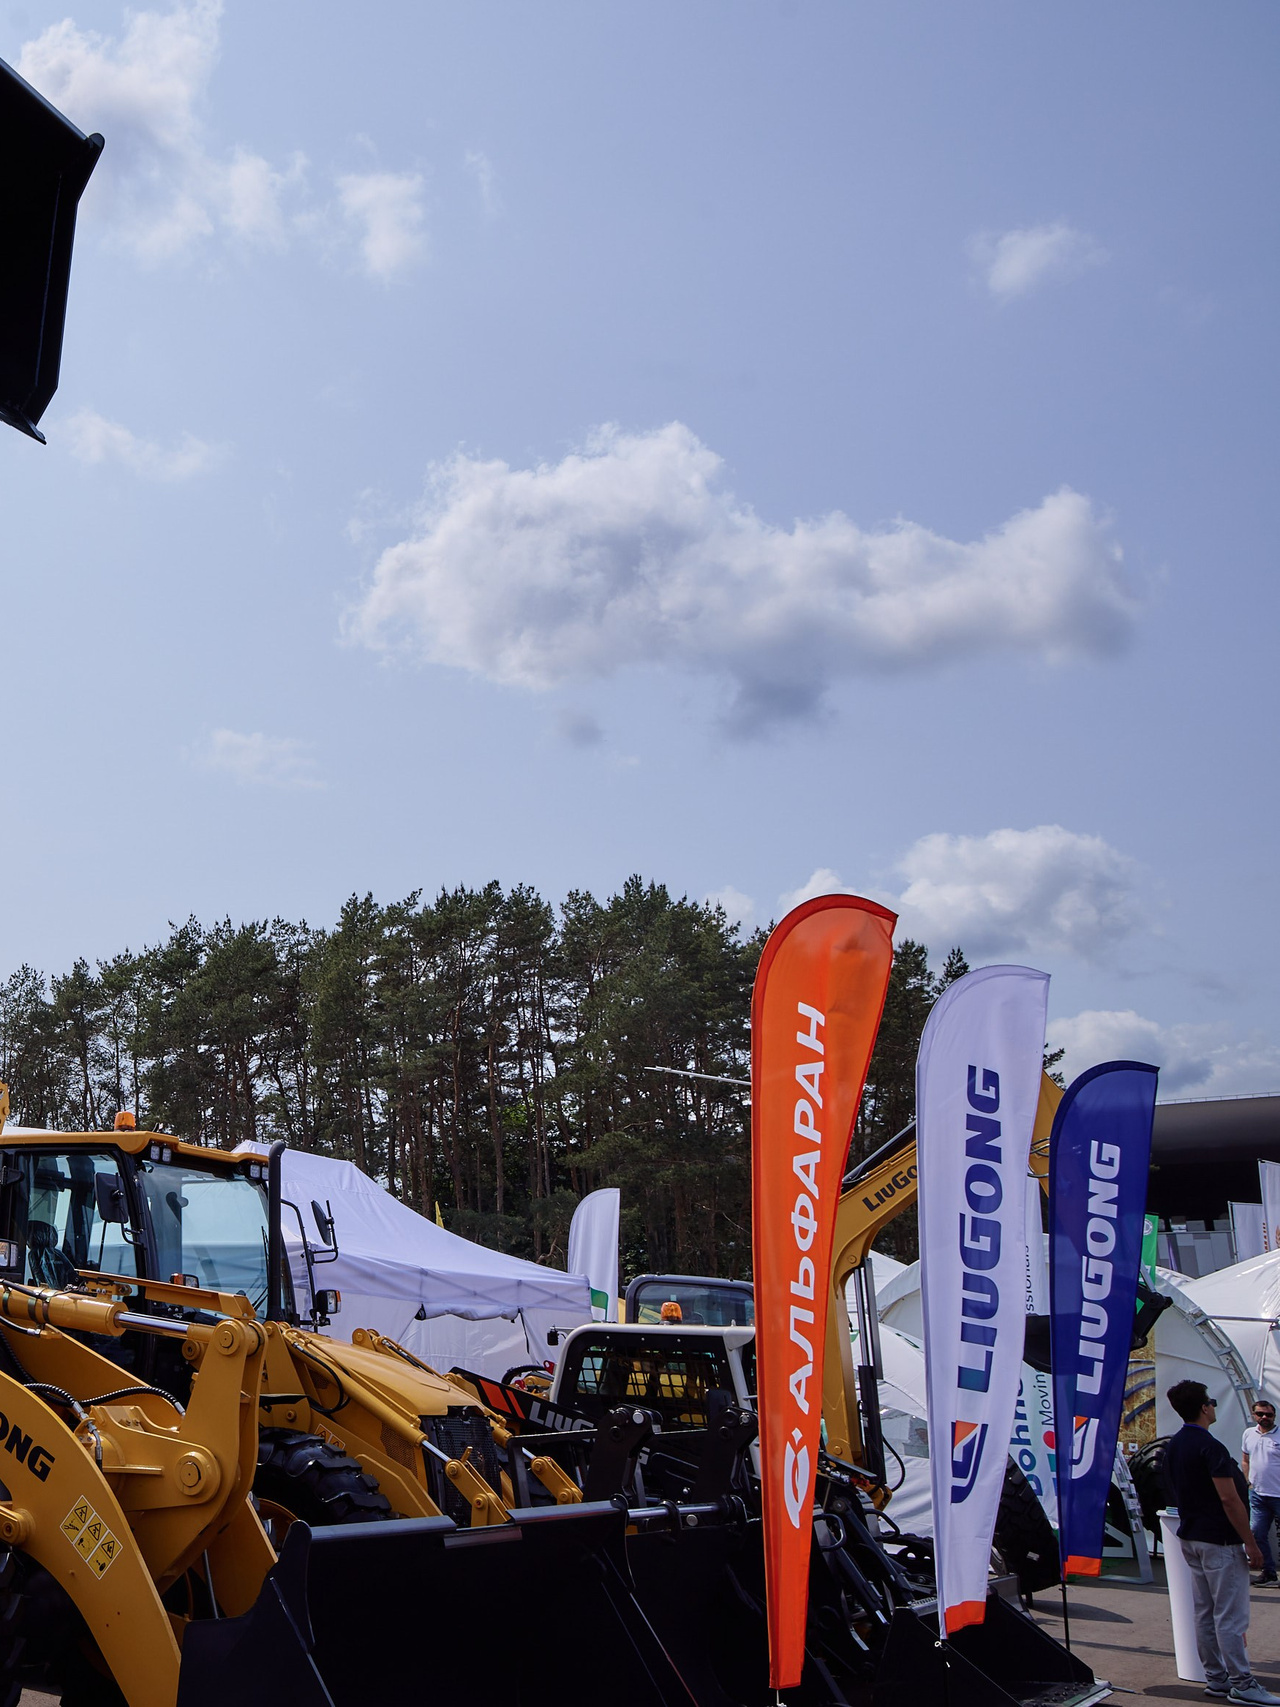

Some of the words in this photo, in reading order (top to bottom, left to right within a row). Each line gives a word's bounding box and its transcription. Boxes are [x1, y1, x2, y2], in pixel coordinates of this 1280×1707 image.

[789, 1001, 825, 1416] АЛЬФАРАН
[862, 1165, 917, 1212] LIUGO
[957, 1064, 1003, 1393] LIUGONG
[1076, 1140, 1121, 1395] LIUGONG
[1033, 1369, 1054, 1426] Movin
